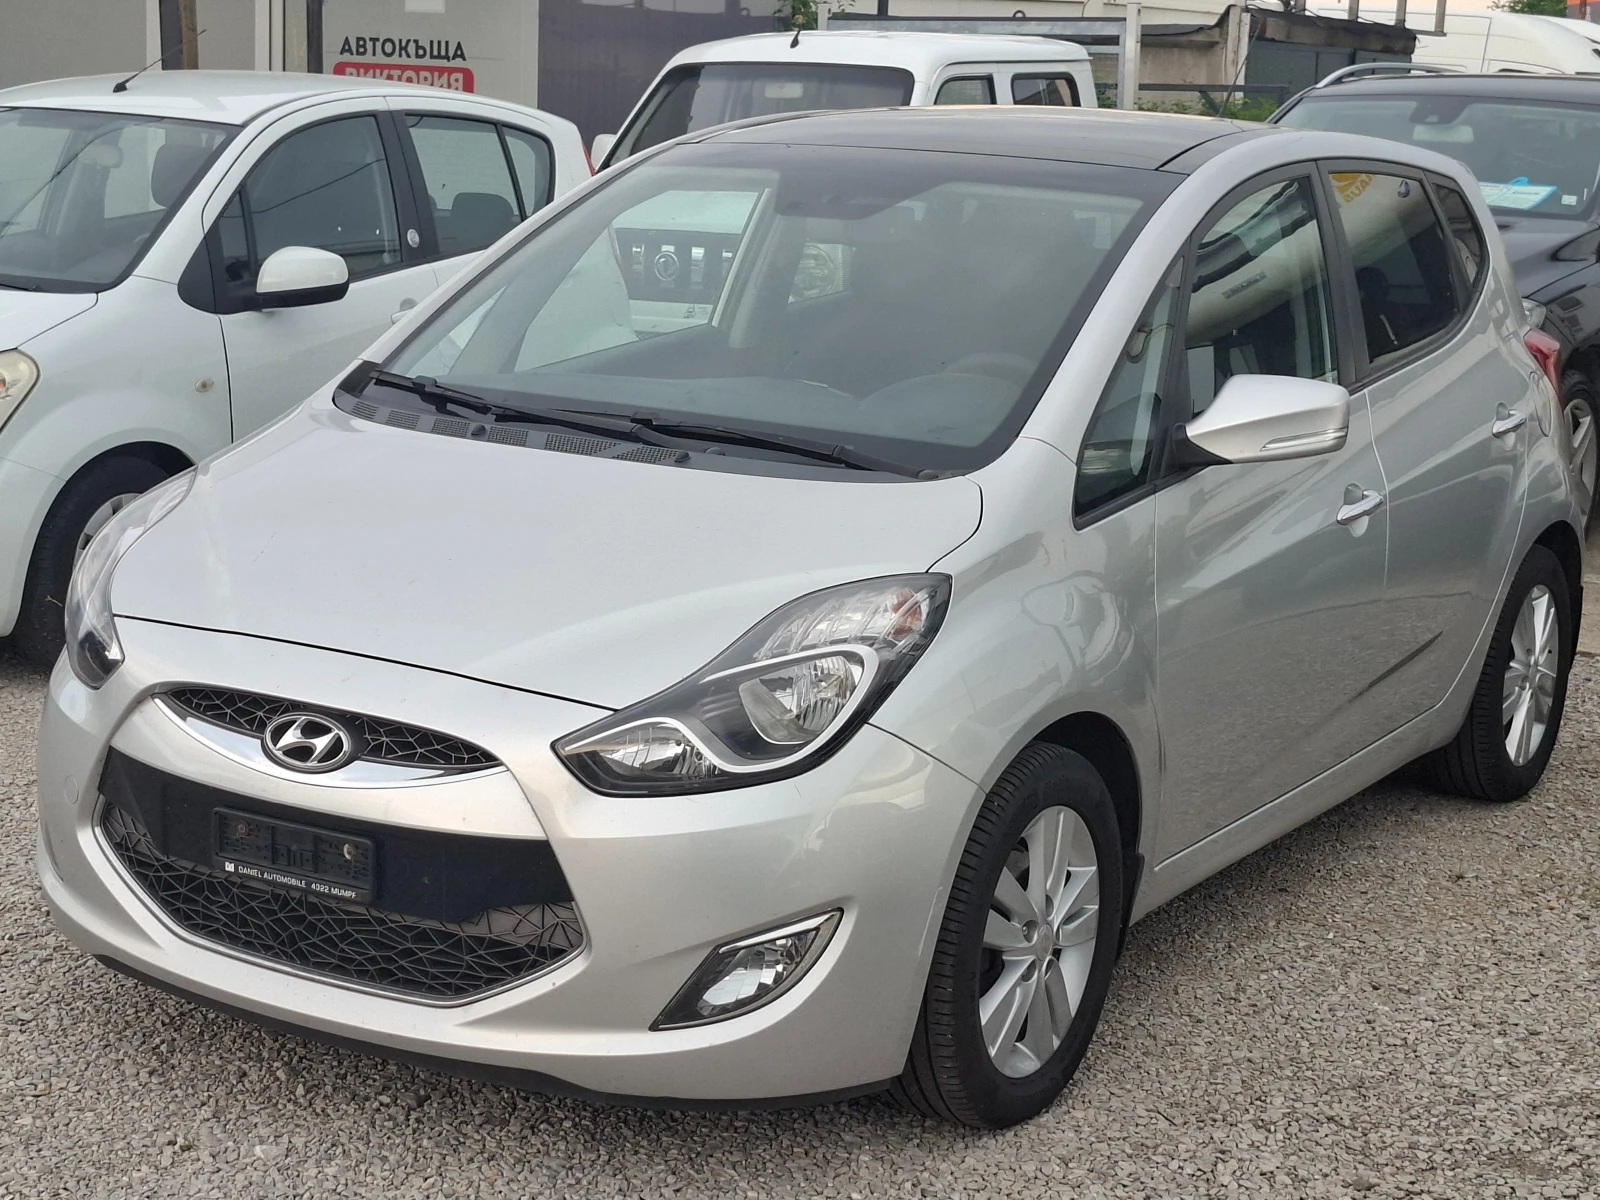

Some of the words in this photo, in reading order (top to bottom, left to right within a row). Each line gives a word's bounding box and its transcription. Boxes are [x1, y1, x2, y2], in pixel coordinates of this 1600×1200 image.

[339, 36, 467, 62] АВТОКЪЩА
[238, 865, 262, 878] DANIEL
[263, 871, 307, 888] AUTOMOBILE
[311, 882, 330, 893] 4322
[331, 887, 357, 899] MUMPF
